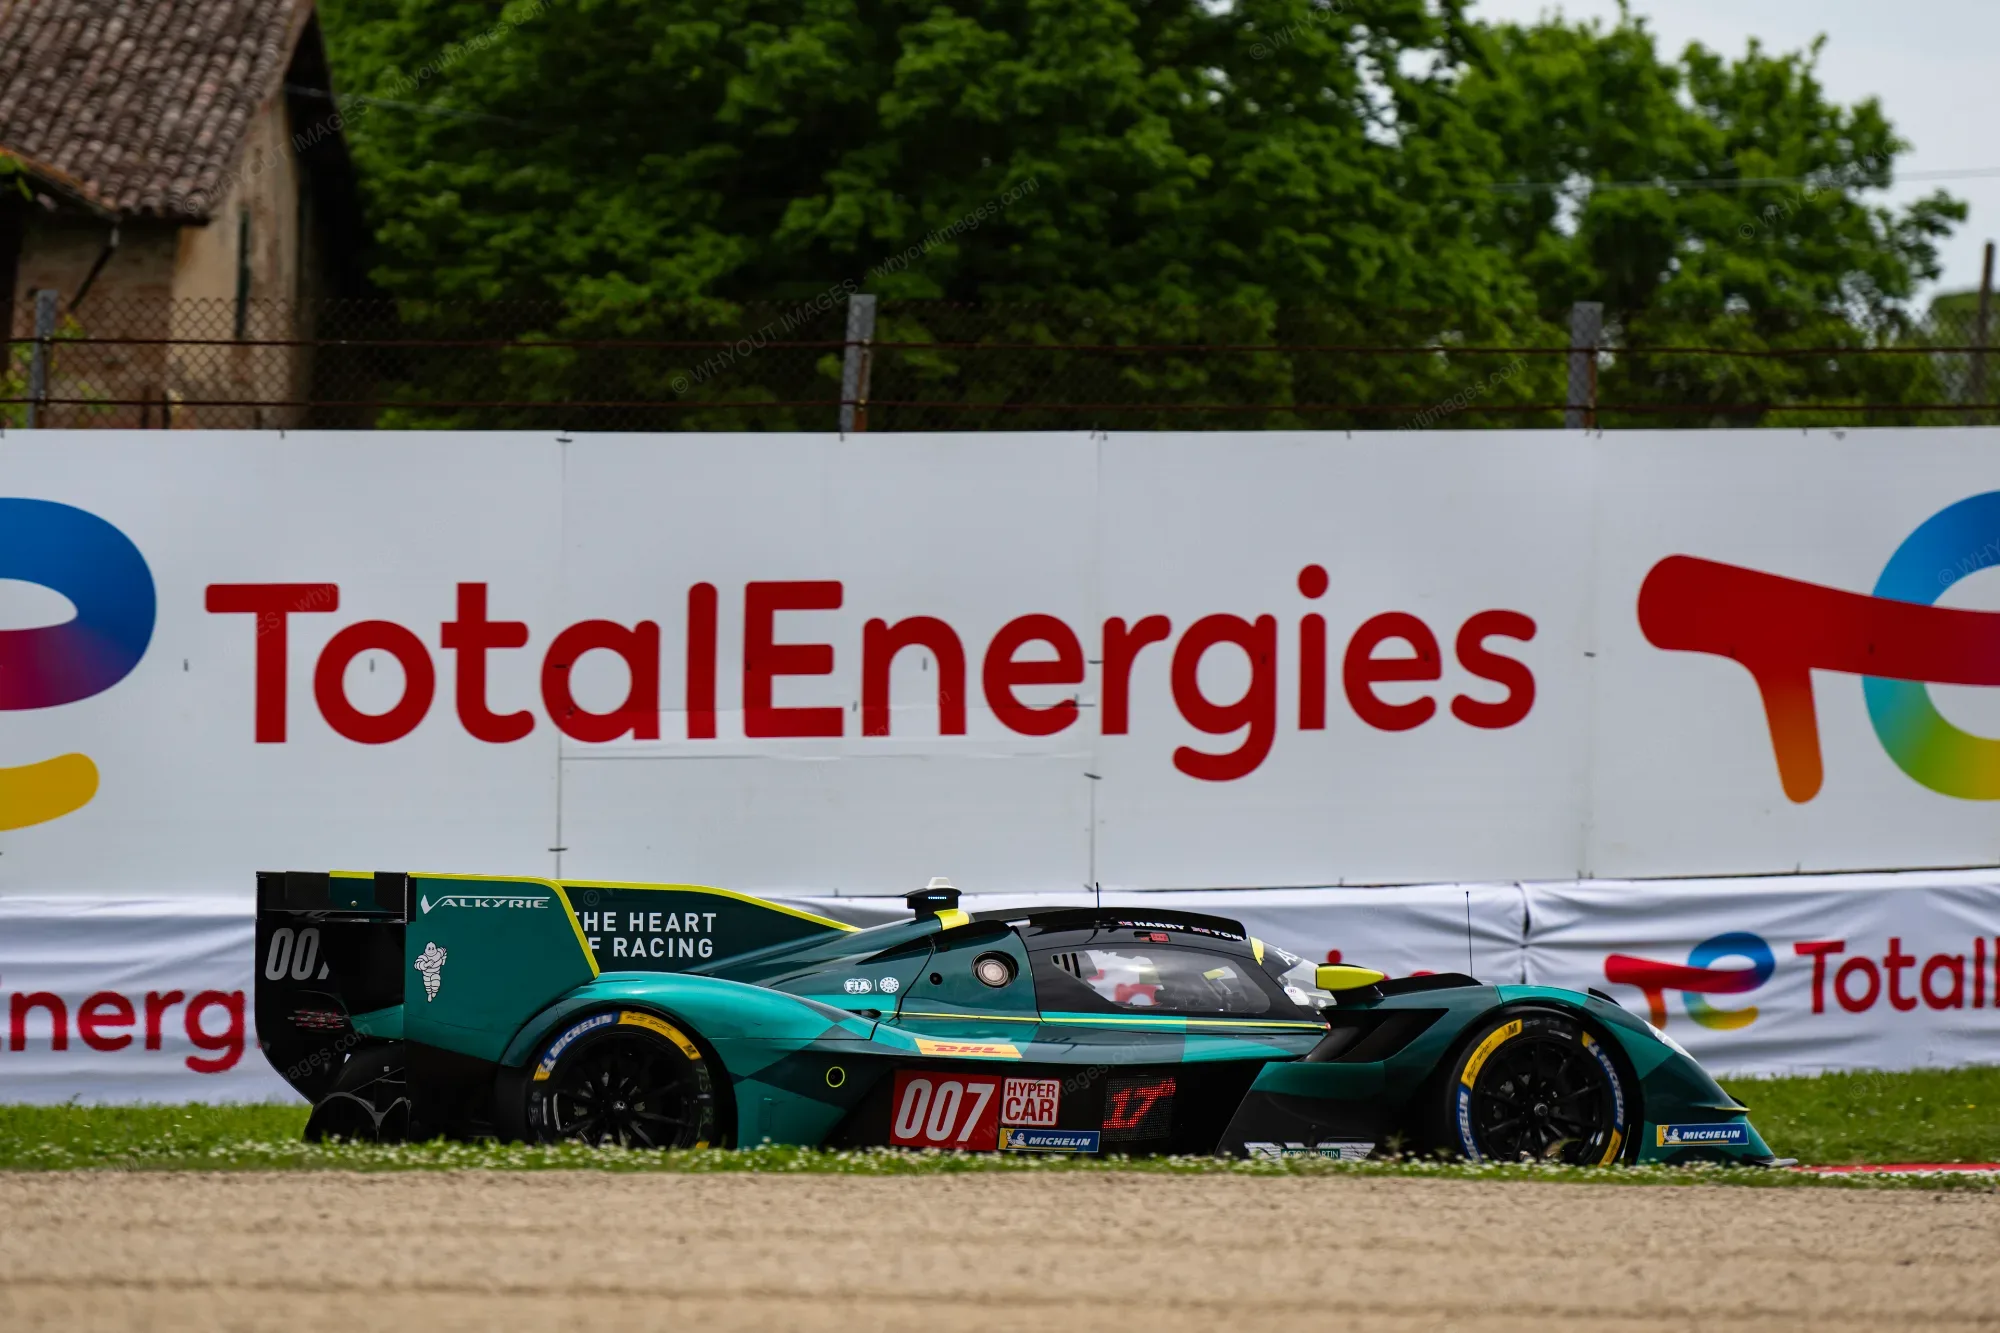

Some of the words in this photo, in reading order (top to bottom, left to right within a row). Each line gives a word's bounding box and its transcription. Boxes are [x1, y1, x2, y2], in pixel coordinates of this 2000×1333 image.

[206, 565, 1536, 782] TotalEnergies
[420, 894, 551, 915] VALKYRIE
[629, 912, 717, 932] HEART
[1134, 921, 1185, 931] HARRY
[265, 927, 330, 980] 00
[588, 936, 602, 952] F
[613, 937, 713, 958] RACING
[1793, 936, 2000, 1014] Total
[10, 990, 245, 1073] nerg
[550, 1013, 614, 1059] MICHELIN
[934, 1044, 1002, 1054] DHL
[1006, 1081, 1056, 1097] HYPER
[1598, 1053, 1626, 1127] MICHELIN
[894, 1079, 996, 1142] 007
[1005, 1097, 1055, 1122] CAR
[1028, 1136, 1091, 1146] MICHELIN
[1683, 1130, 1740, 1140] MICHELIN
